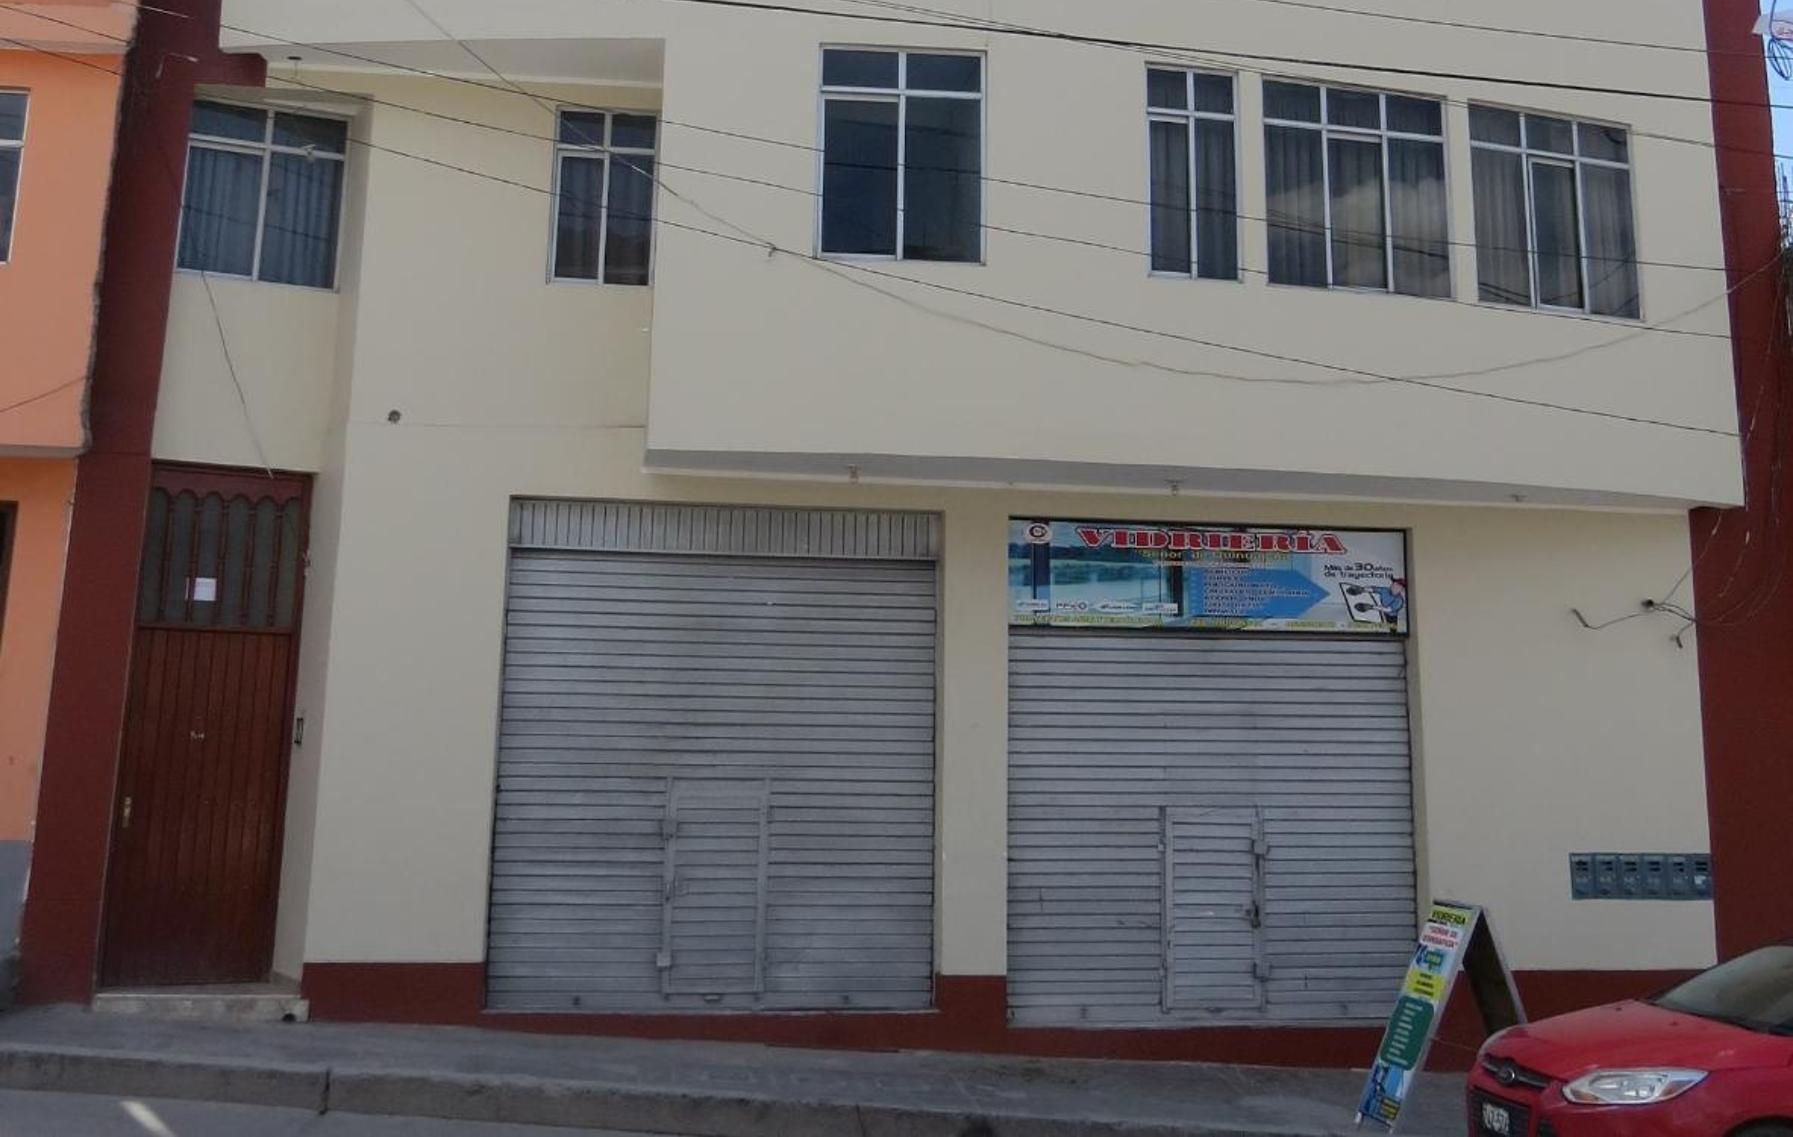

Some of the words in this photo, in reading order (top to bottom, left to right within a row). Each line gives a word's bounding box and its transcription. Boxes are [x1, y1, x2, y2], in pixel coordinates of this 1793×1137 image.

[1076, 526, 1347, 555] VIDRIERÍA
[1324, 563, 1342, 571] Más
[1353, 562, 1373, 572] 30
[1340, 571, 1394, 580] trayectoria
